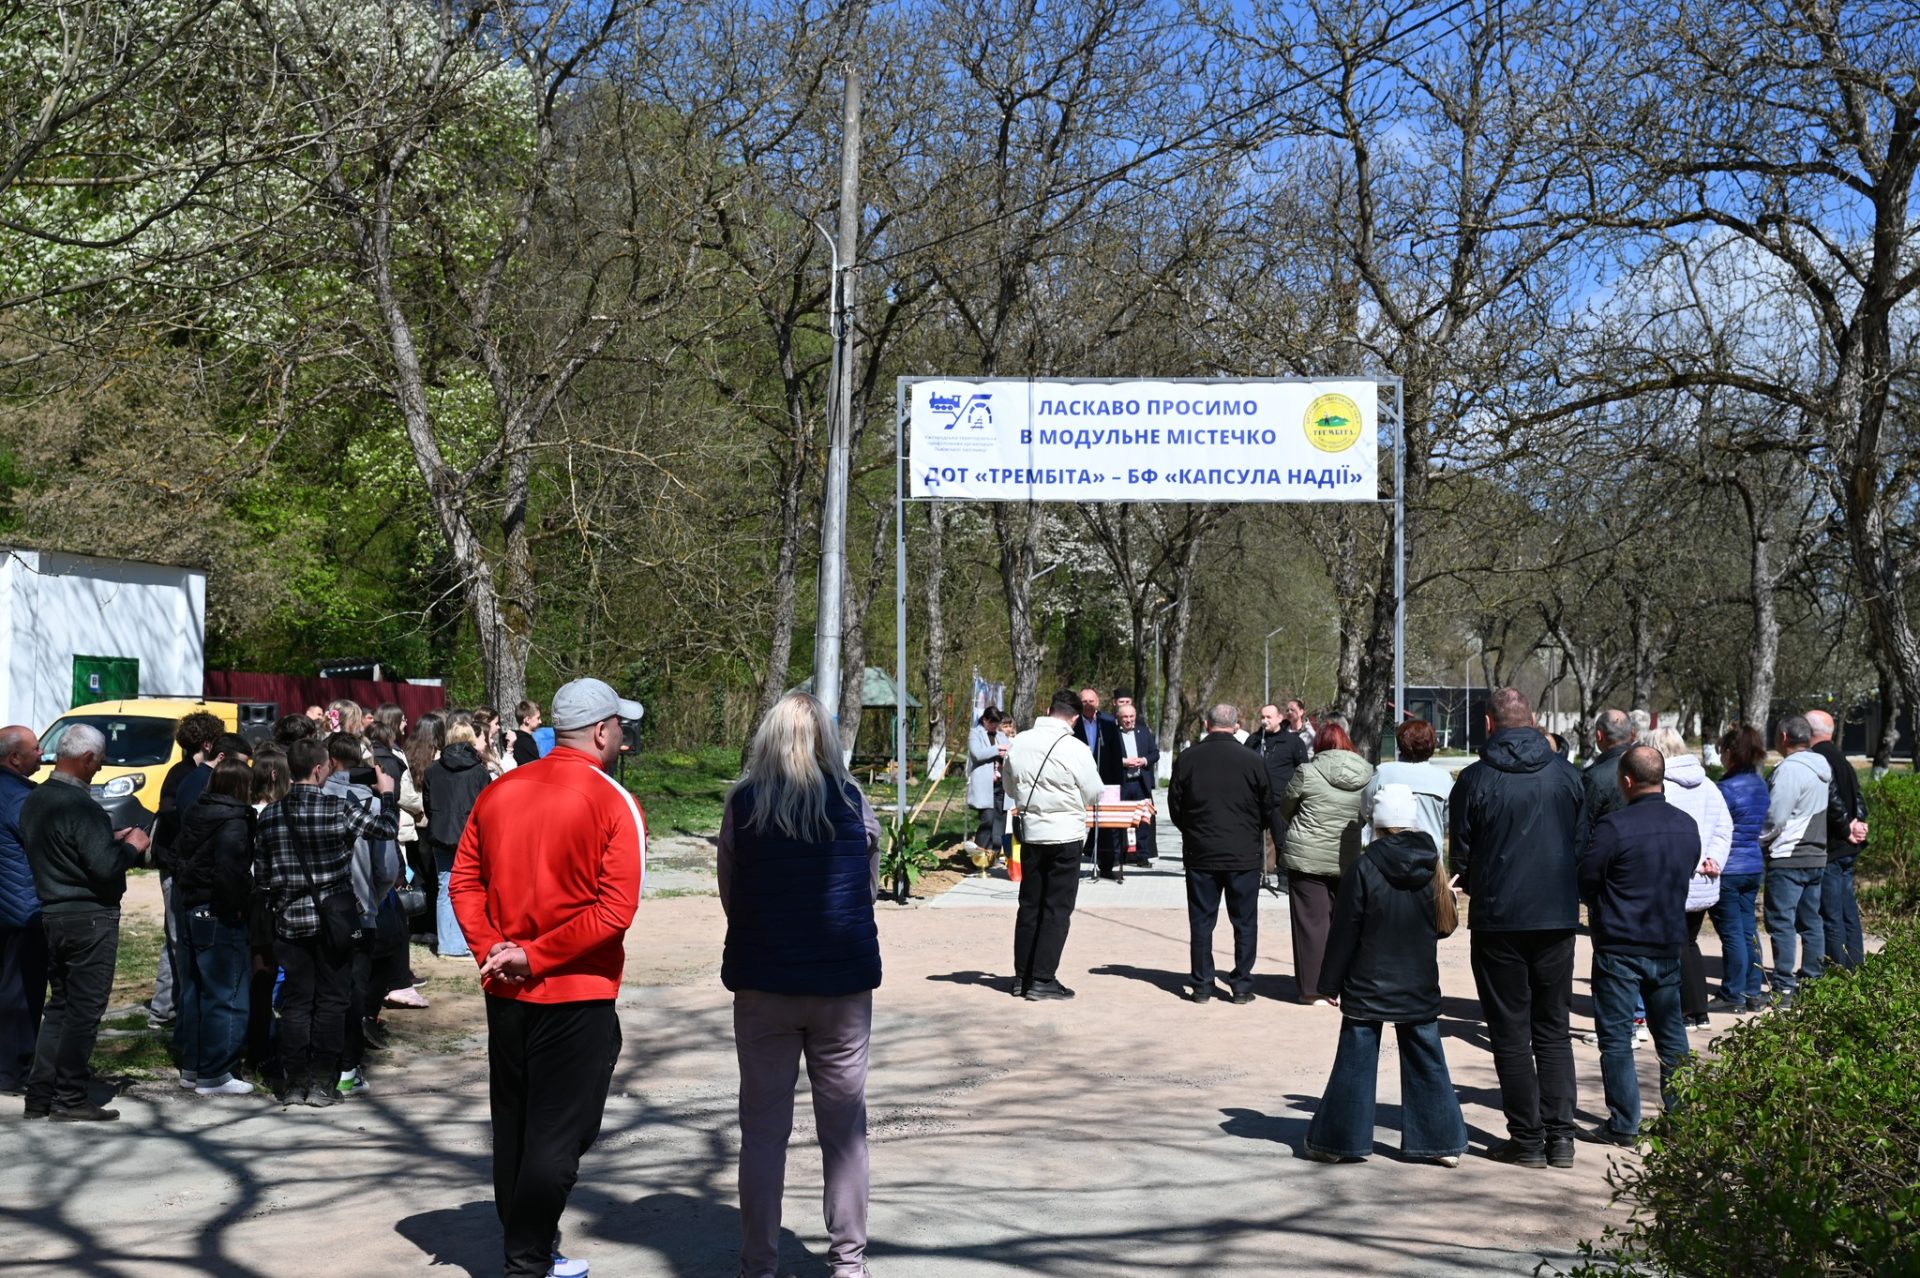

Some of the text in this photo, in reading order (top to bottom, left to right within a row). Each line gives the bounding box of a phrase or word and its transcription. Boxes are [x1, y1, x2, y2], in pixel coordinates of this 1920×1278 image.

[1039, 399, 1258, 417] ЛАСКАВО ПРОСИМО
[1020, 428, 1277, 449] В МОДУЛЬНЕ МІСТЕЧКО
[923, 466, 970, 488] ДОТ
[975, 467, 1105, 485] «ТРЕМБІТА»
[1127, 467, 1159, 485] БФ
[1165, 467, 1282, 486] «КАПСУЛА
[1287, 465, 1363, 490] НАДІЇ»
